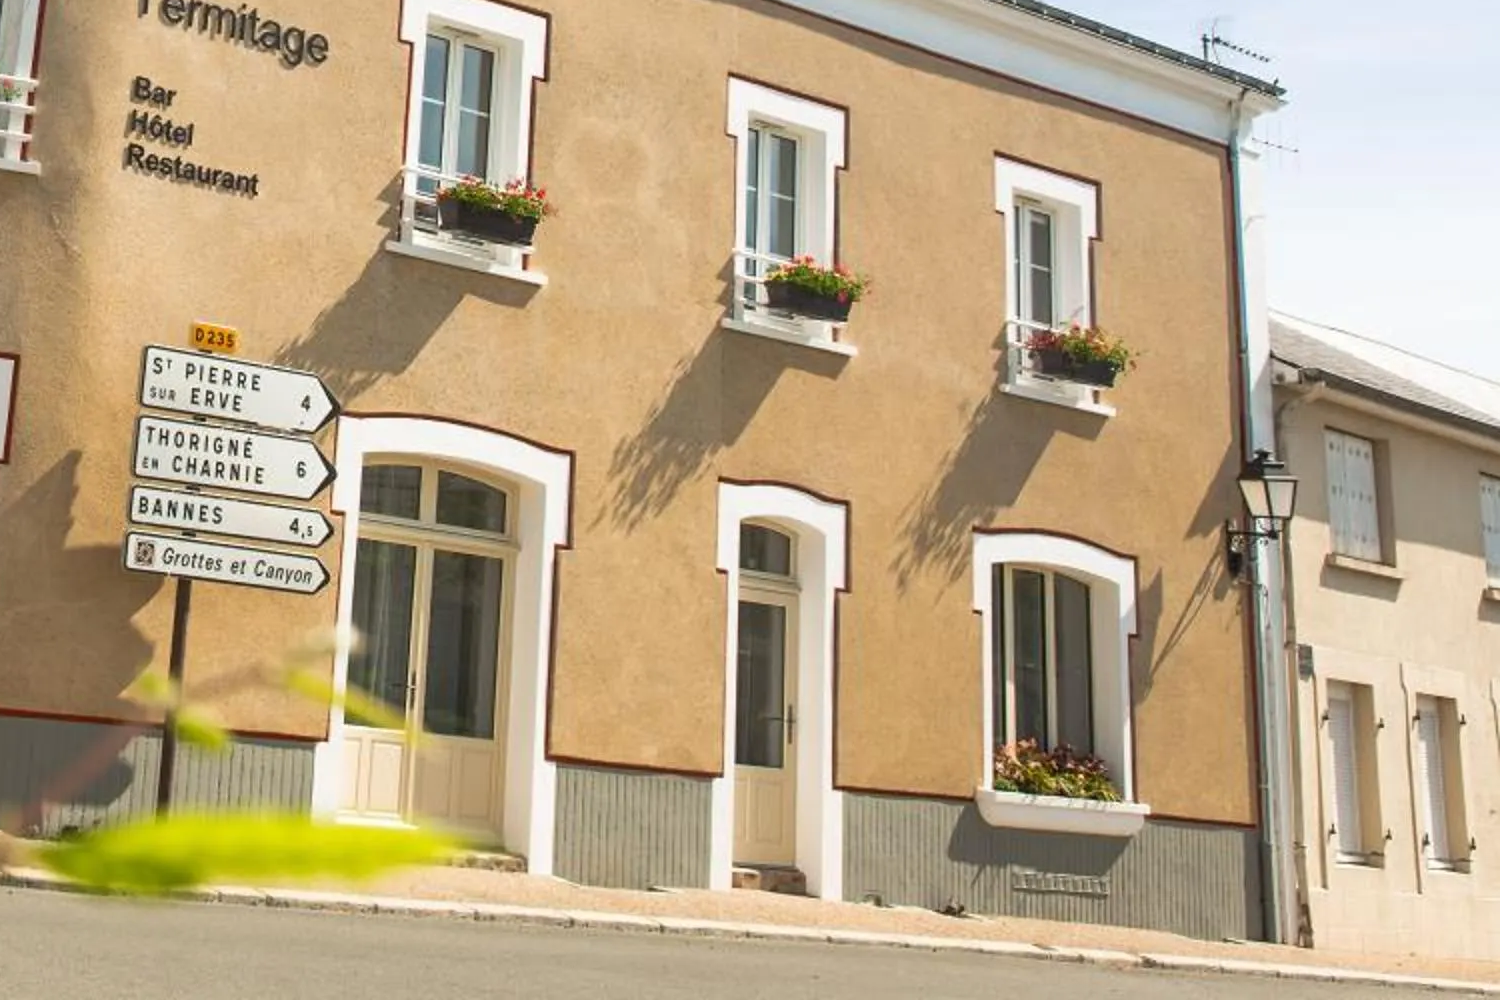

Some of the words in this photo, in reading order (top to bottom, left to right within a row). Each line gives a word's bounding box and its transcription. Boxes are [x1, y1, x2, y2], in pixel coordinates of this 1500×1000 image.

[130, 75, 177, 109] Bar
[125, 109, 195, 148] Hôtel
[123, 143, 259, 198] Restaurant
[184, 362, 261, 392] PIERRE
[149, 386, 177, 402] SUR
[190, 387, 243, 413] ERVE
[300, 395, 311, 412] 4
[146, 426, 253, 459] THORIGNÉ
[142, 456, 159, 470] EN
[172, 456, 265, 485] CHARNIE
[296, 461, 307, 479] 6
[138, 496, 224, 525] BANNES
[289, 517, 313, 539] 4,5
[162, 547, 223, 572] Grottes
[230, 557, 247, 575] et
[254, 558, 313, 586] Canyon
